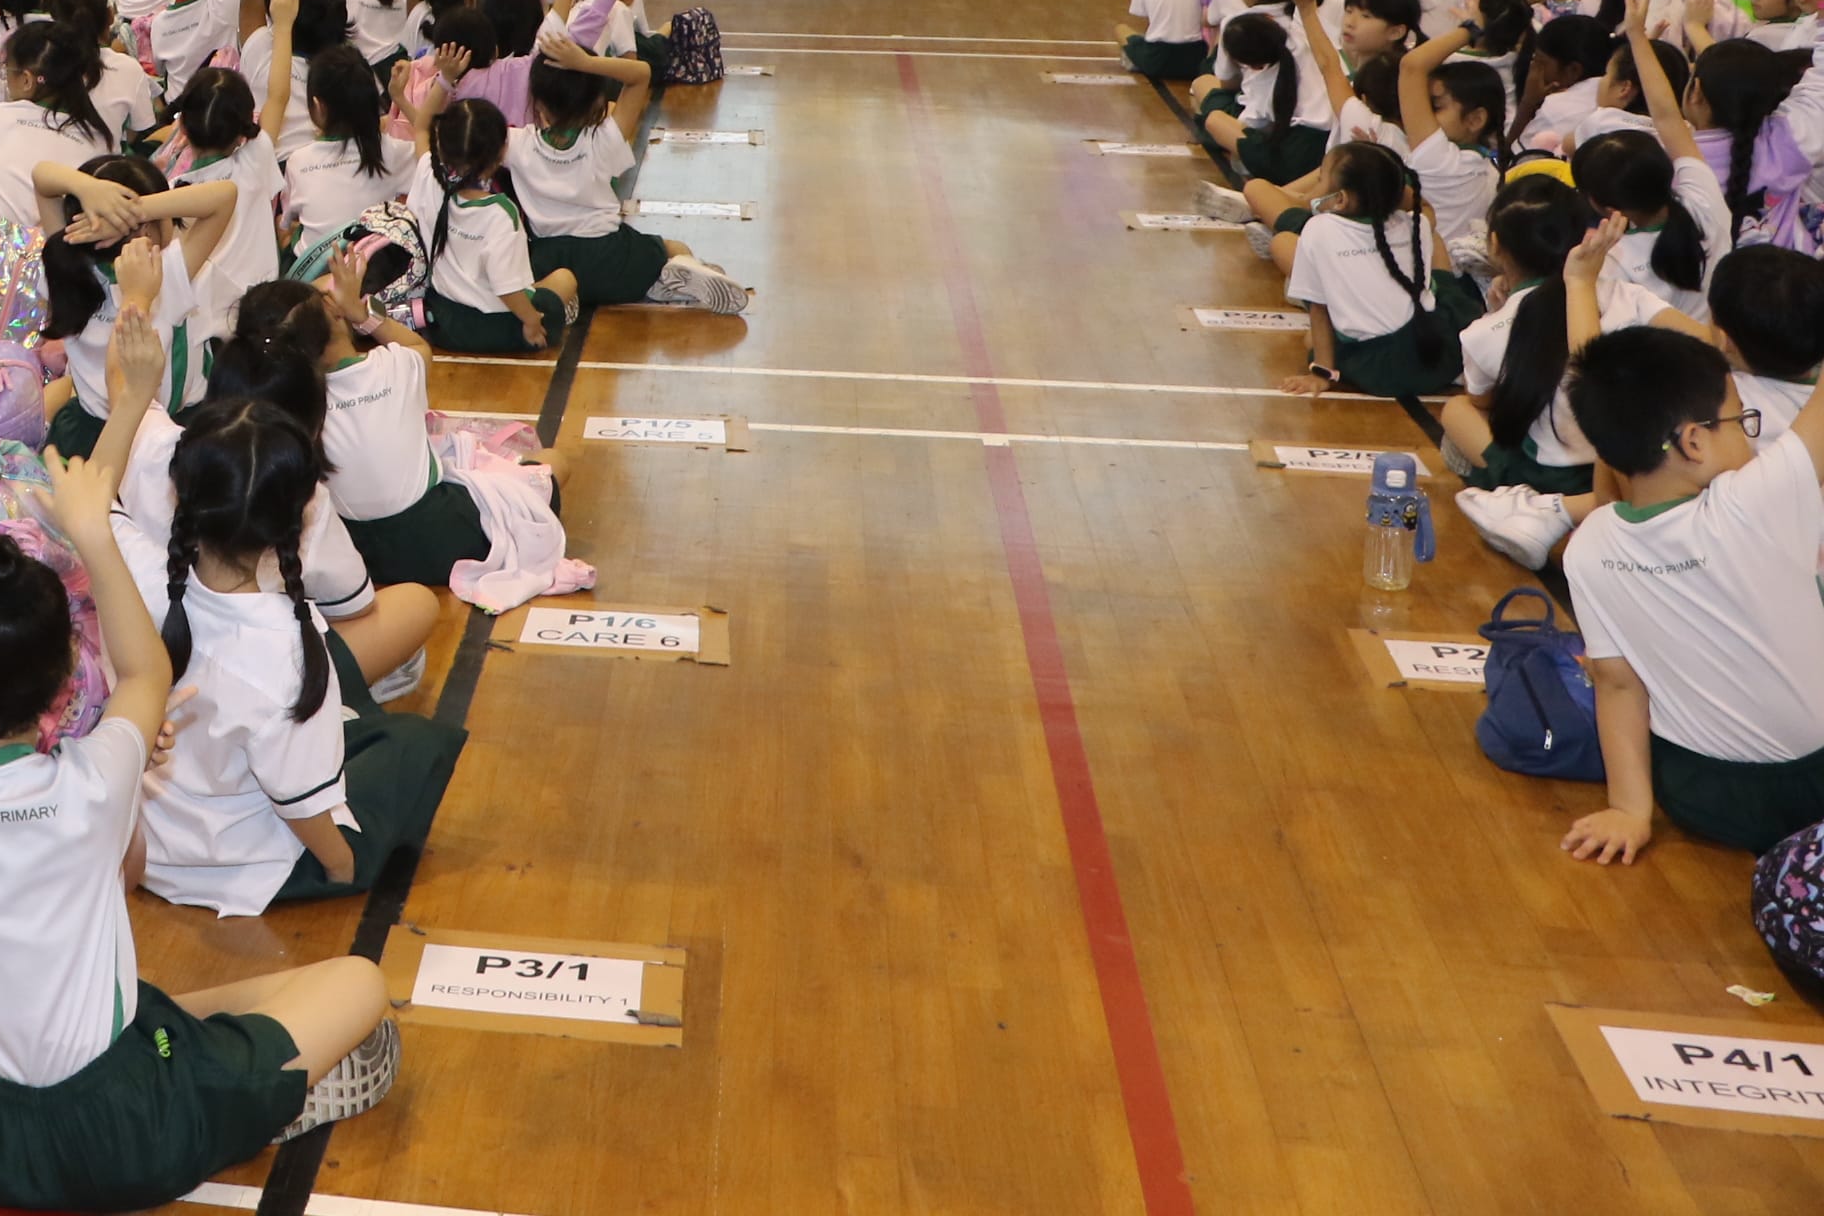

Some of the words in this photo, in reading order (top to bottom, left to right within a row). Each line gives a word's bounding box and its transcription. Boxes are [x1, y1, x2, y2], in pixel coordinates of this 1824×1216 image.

[358, 388, 393, 406] PRIMARY
[621, 419, 692, 429] P1/5
[597, 429, 685, 441] CARE
[698, 431, 713, 441] 5
[569, 614, 657, 630] P1/6
[537, 628, 646, 647] CARE
[661, 636, 681, 648] 6
[476, 955, 589, 982] P3/1
[431, 984, 610, 1006] RESPONSIBILITY
[620, 997, 628, 1006] 1
